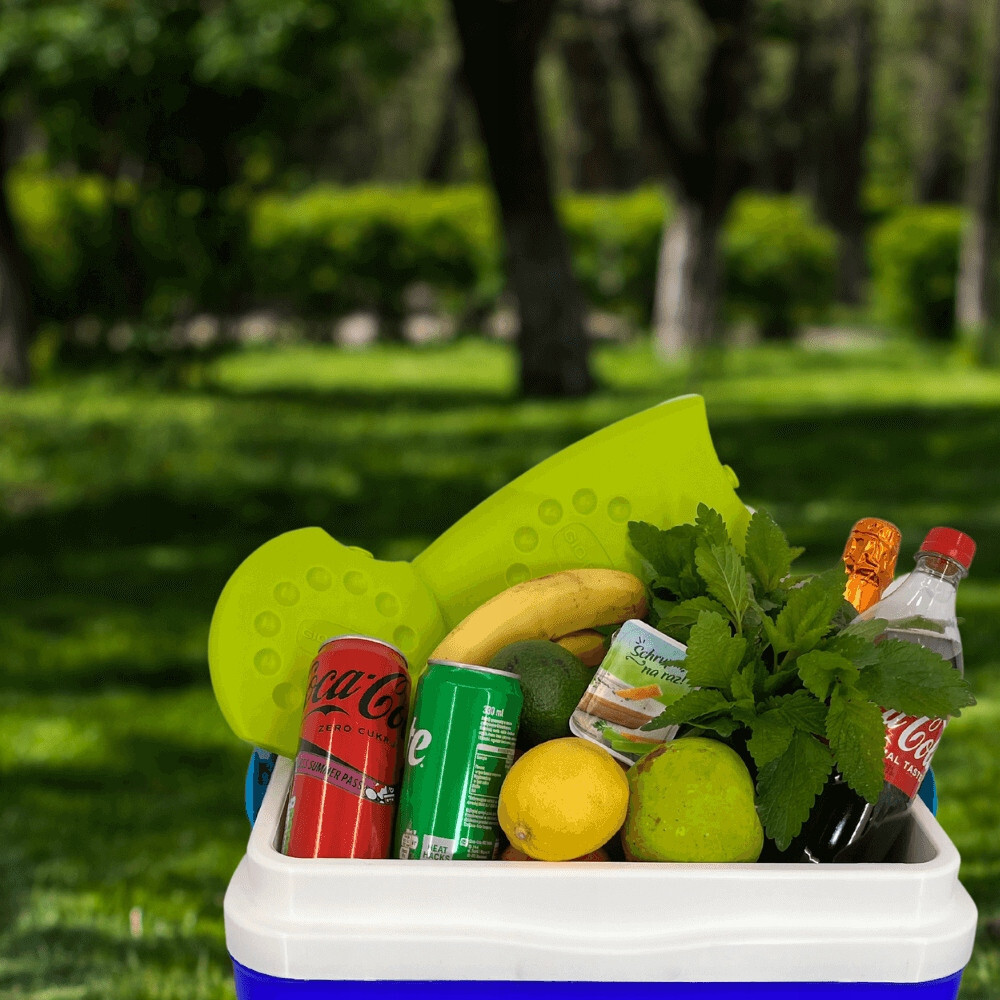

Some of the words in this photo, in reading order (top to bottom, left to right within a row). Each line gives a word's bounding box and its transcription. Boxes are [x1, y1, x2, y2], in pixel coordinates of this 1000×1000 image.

[641, 665, 659, 678] na
[660, 671, 687, 685] raz!
[495, 708, 504, 718] ml
[318, 723, 352, 734] ZERO
[307, 760, 341, 782] SUMMER
[341, 772, 363, 790] PASS
[427, 843, 449, 854] HEAT
[422, 850, 451, 861] HACKS
